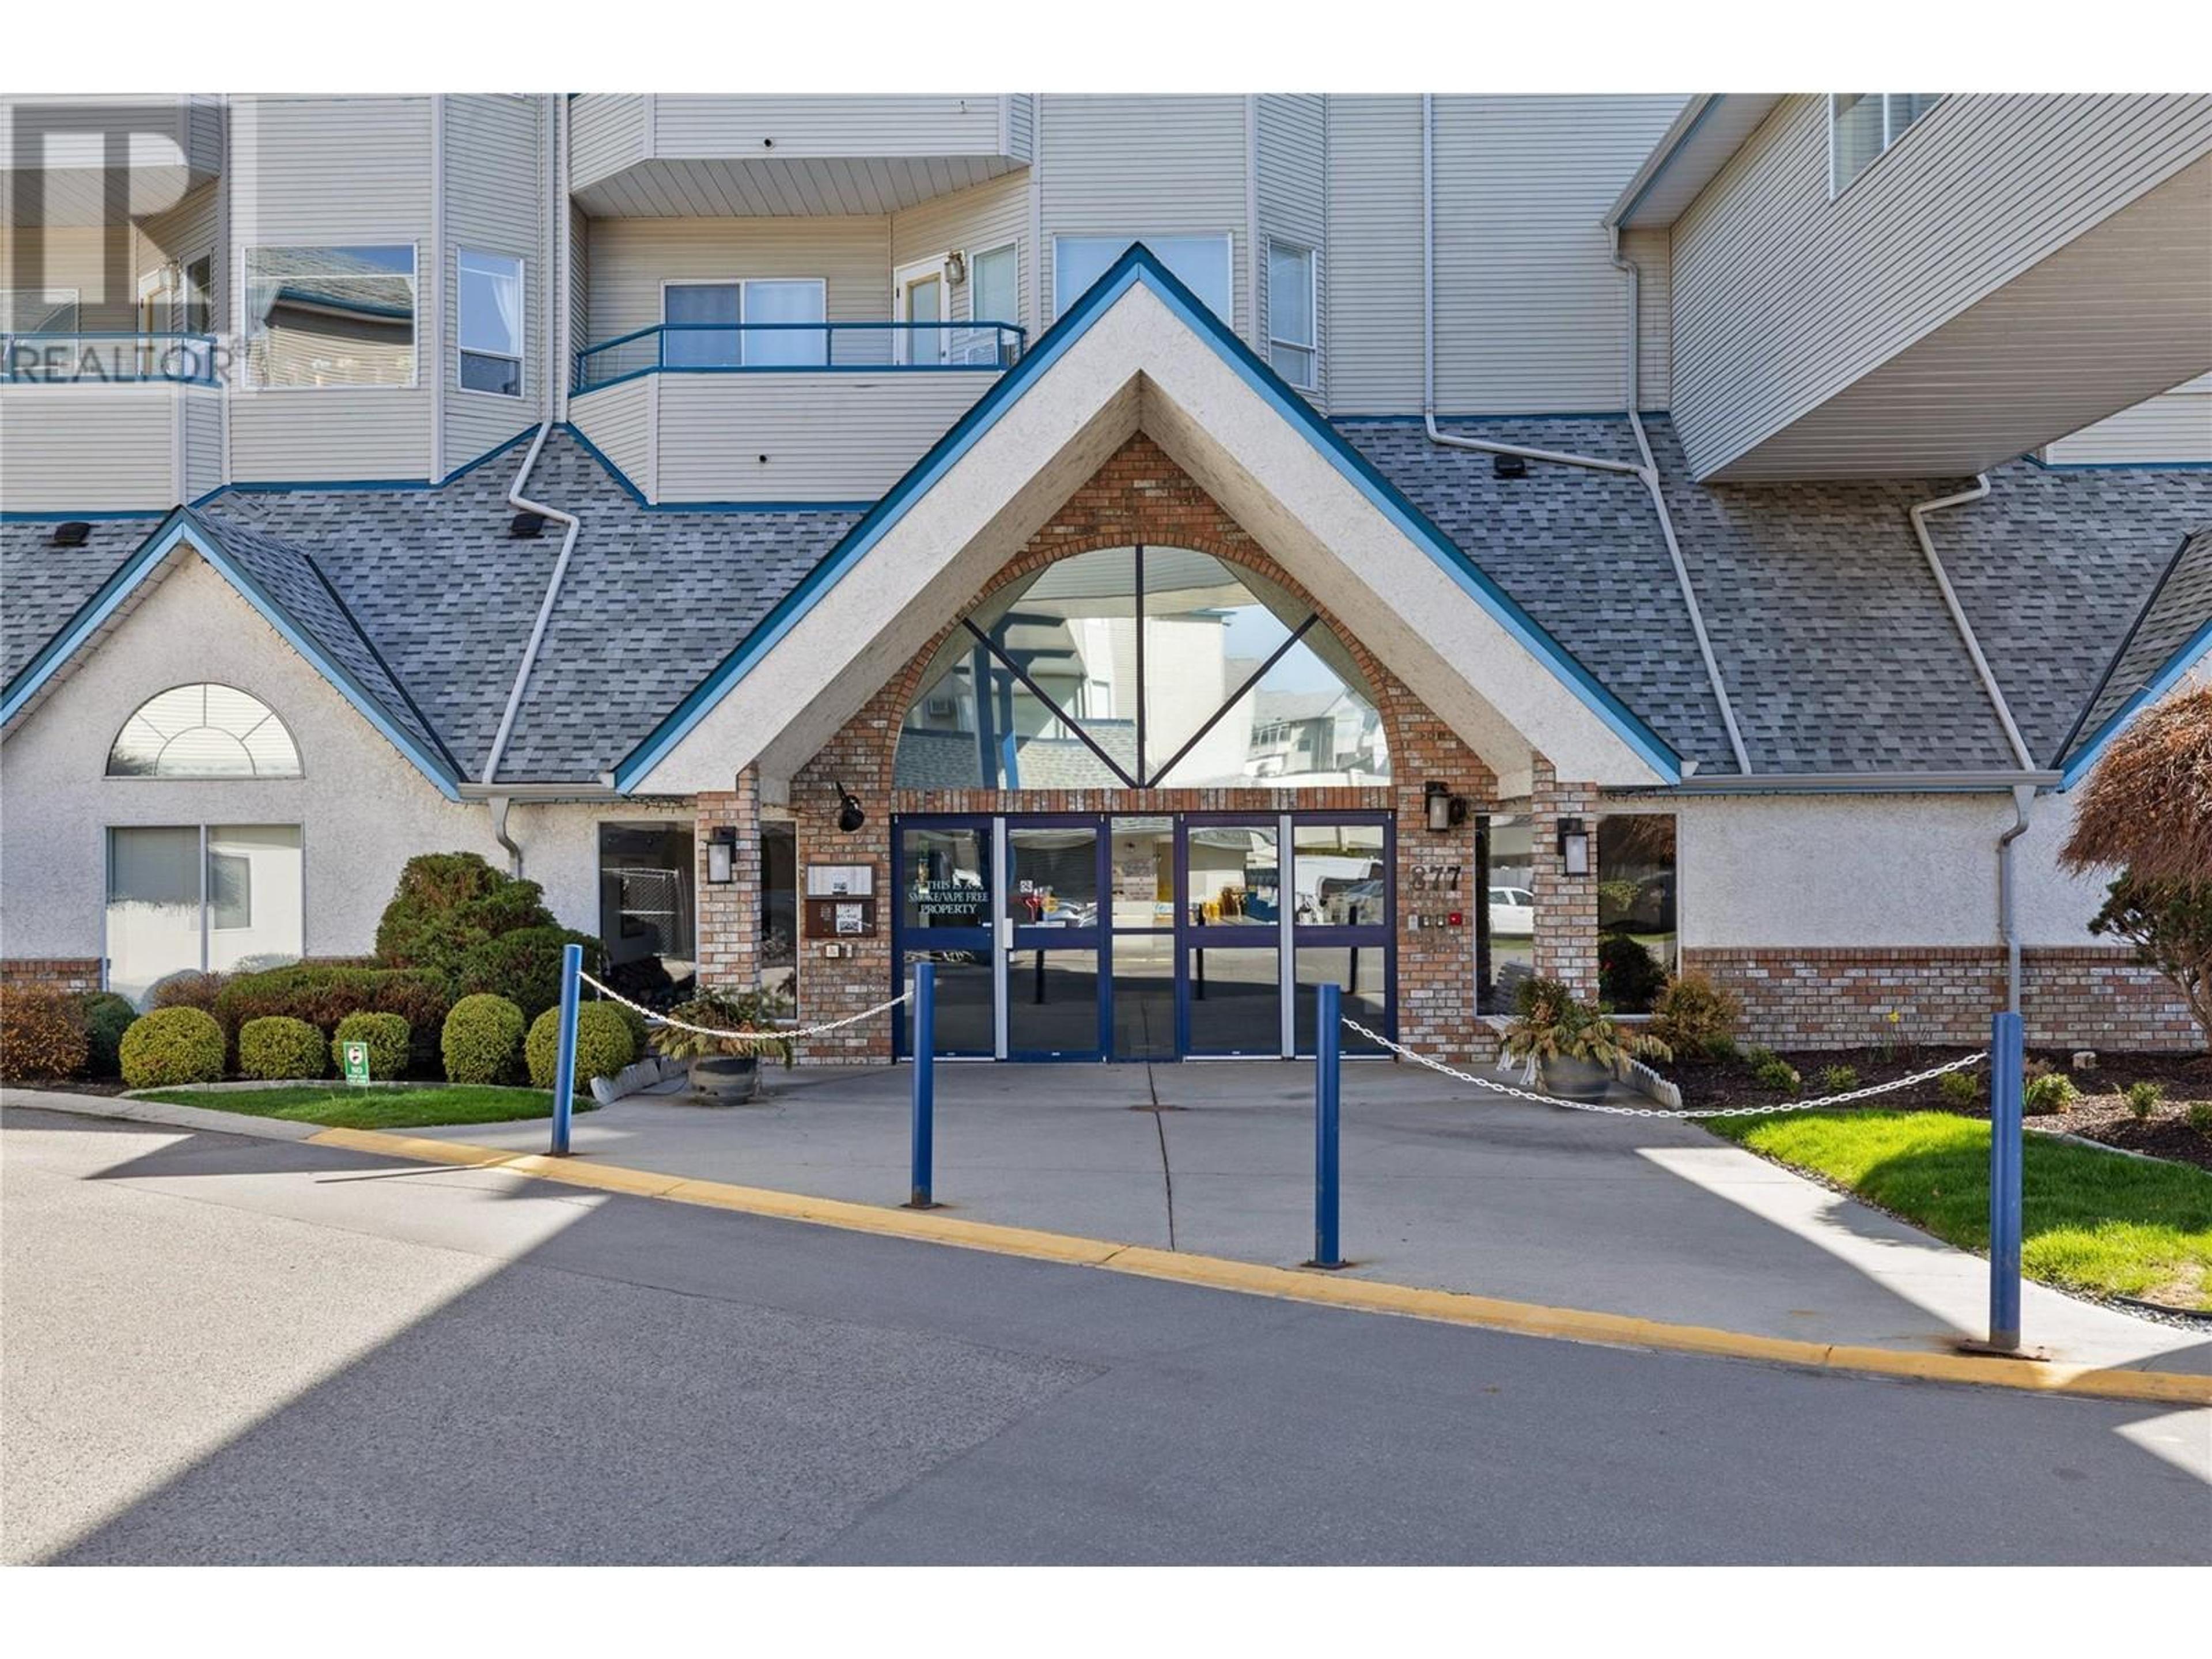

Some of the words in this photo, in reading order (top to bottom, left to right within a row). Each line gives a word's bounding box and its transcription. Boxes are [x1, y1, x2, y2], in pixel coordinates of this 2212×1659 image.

[1411, 865, 1461, 891] 877
[926, 881, 950, 890] THIS
[908, 892, 965, 903] SMOKE/VAPE
[966, 892, 989, 903] FREE
[919, 904, 978, 914] PROPERTY
